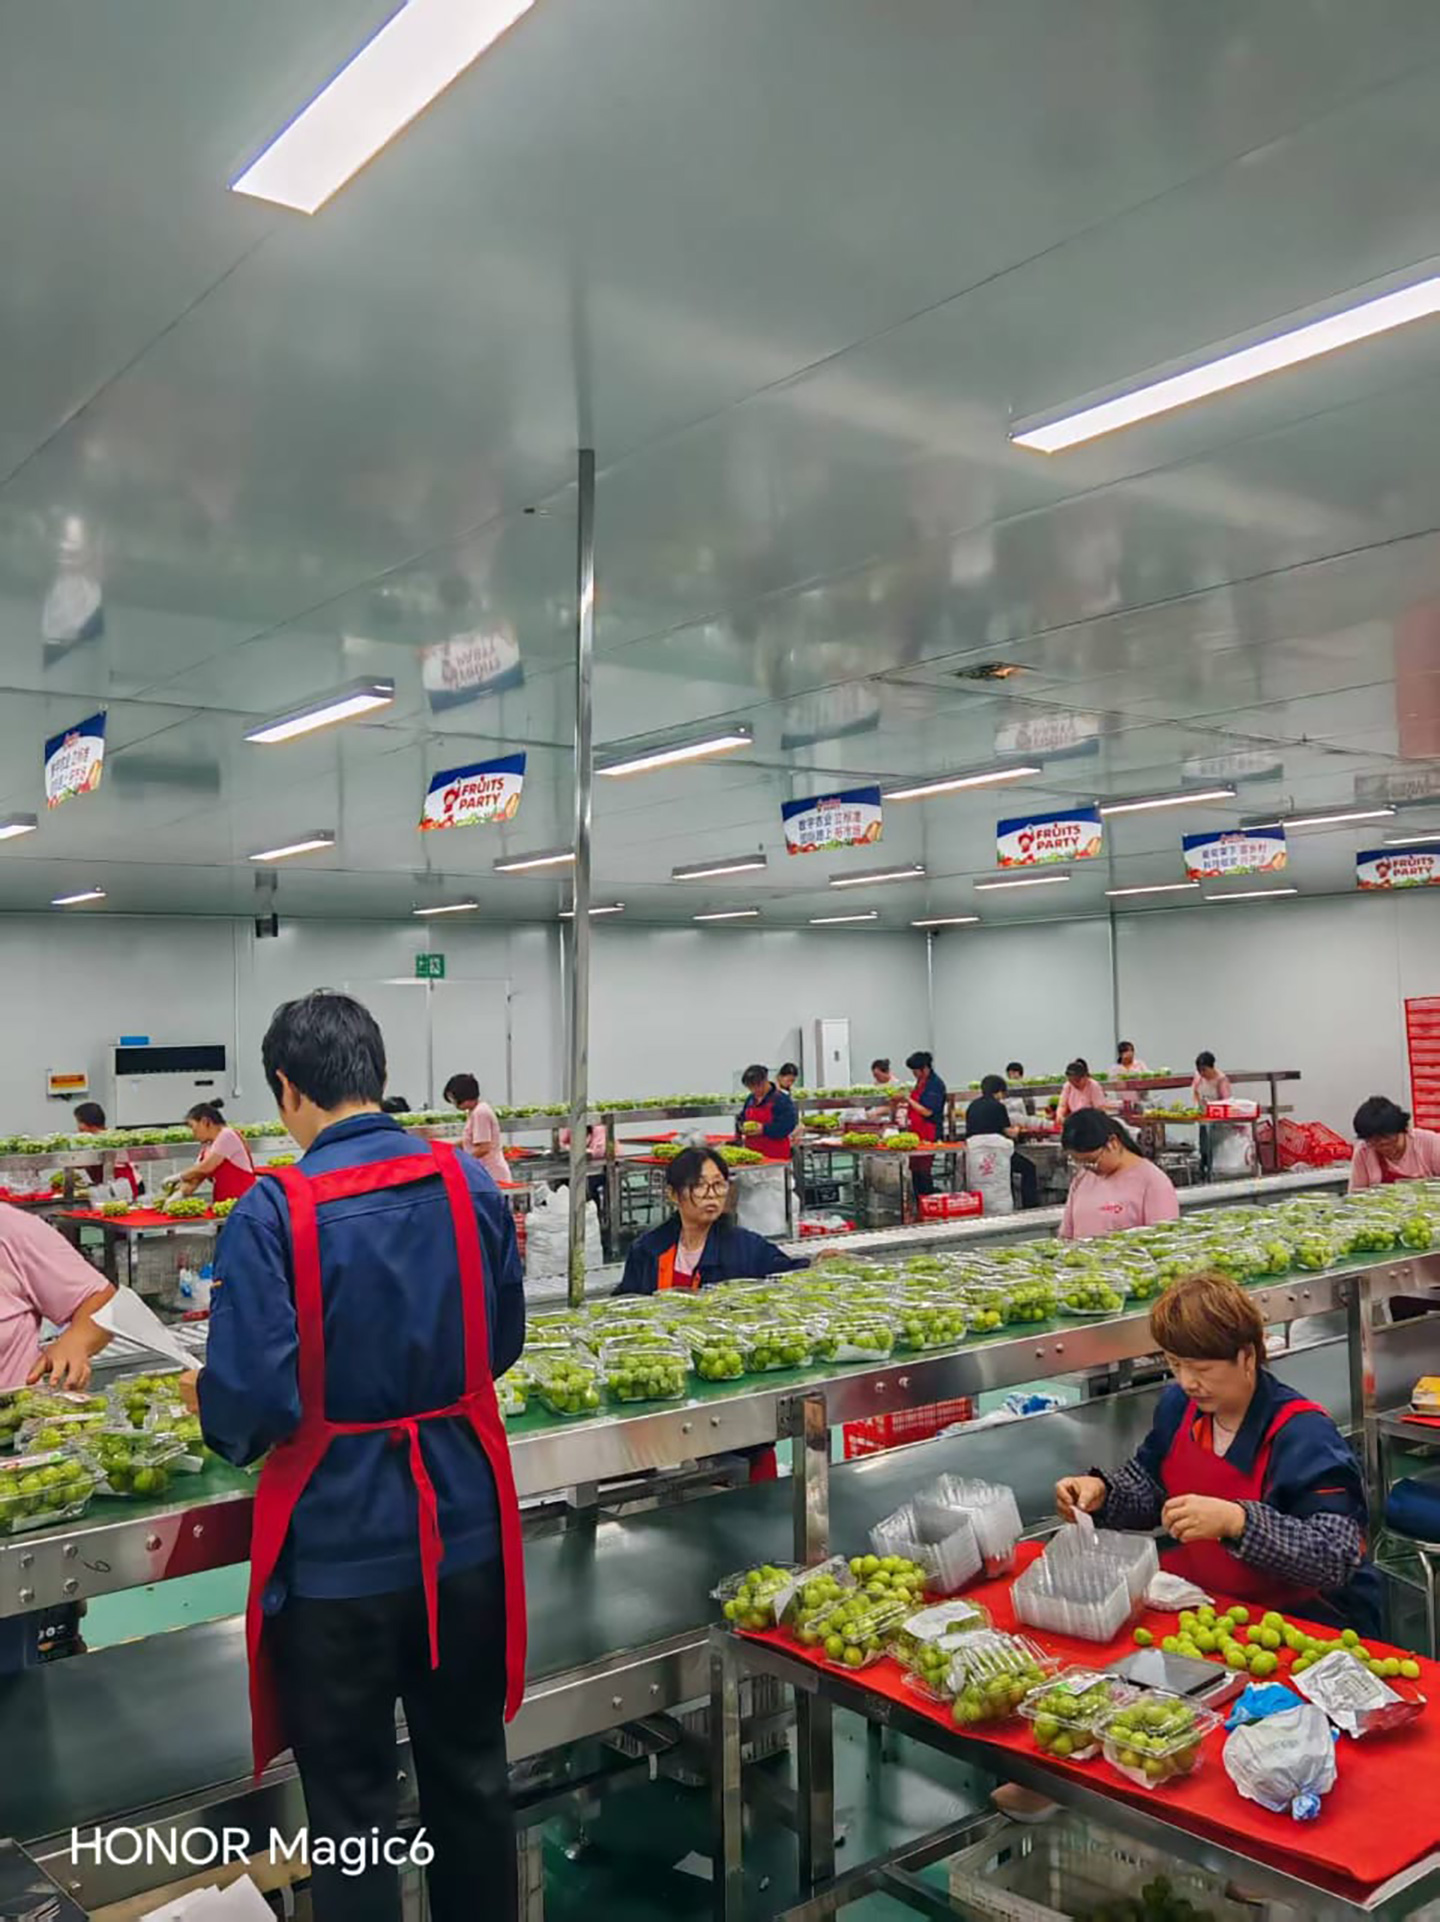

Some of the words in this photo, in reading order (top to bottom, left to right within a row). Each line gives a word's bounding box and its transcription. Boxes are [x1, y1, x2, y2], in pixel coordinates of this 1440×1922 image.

[462, 775, 504, 796] FRUITS
[459, 792, 501, 811] PARTY
[1036, 821, 1081, 840] FRUITS
[1036, 837, 1079, 850] PARTY
[1393, 855, 1434, 868] FRUITS
[1393, 867, 1432, 877] PARTY
